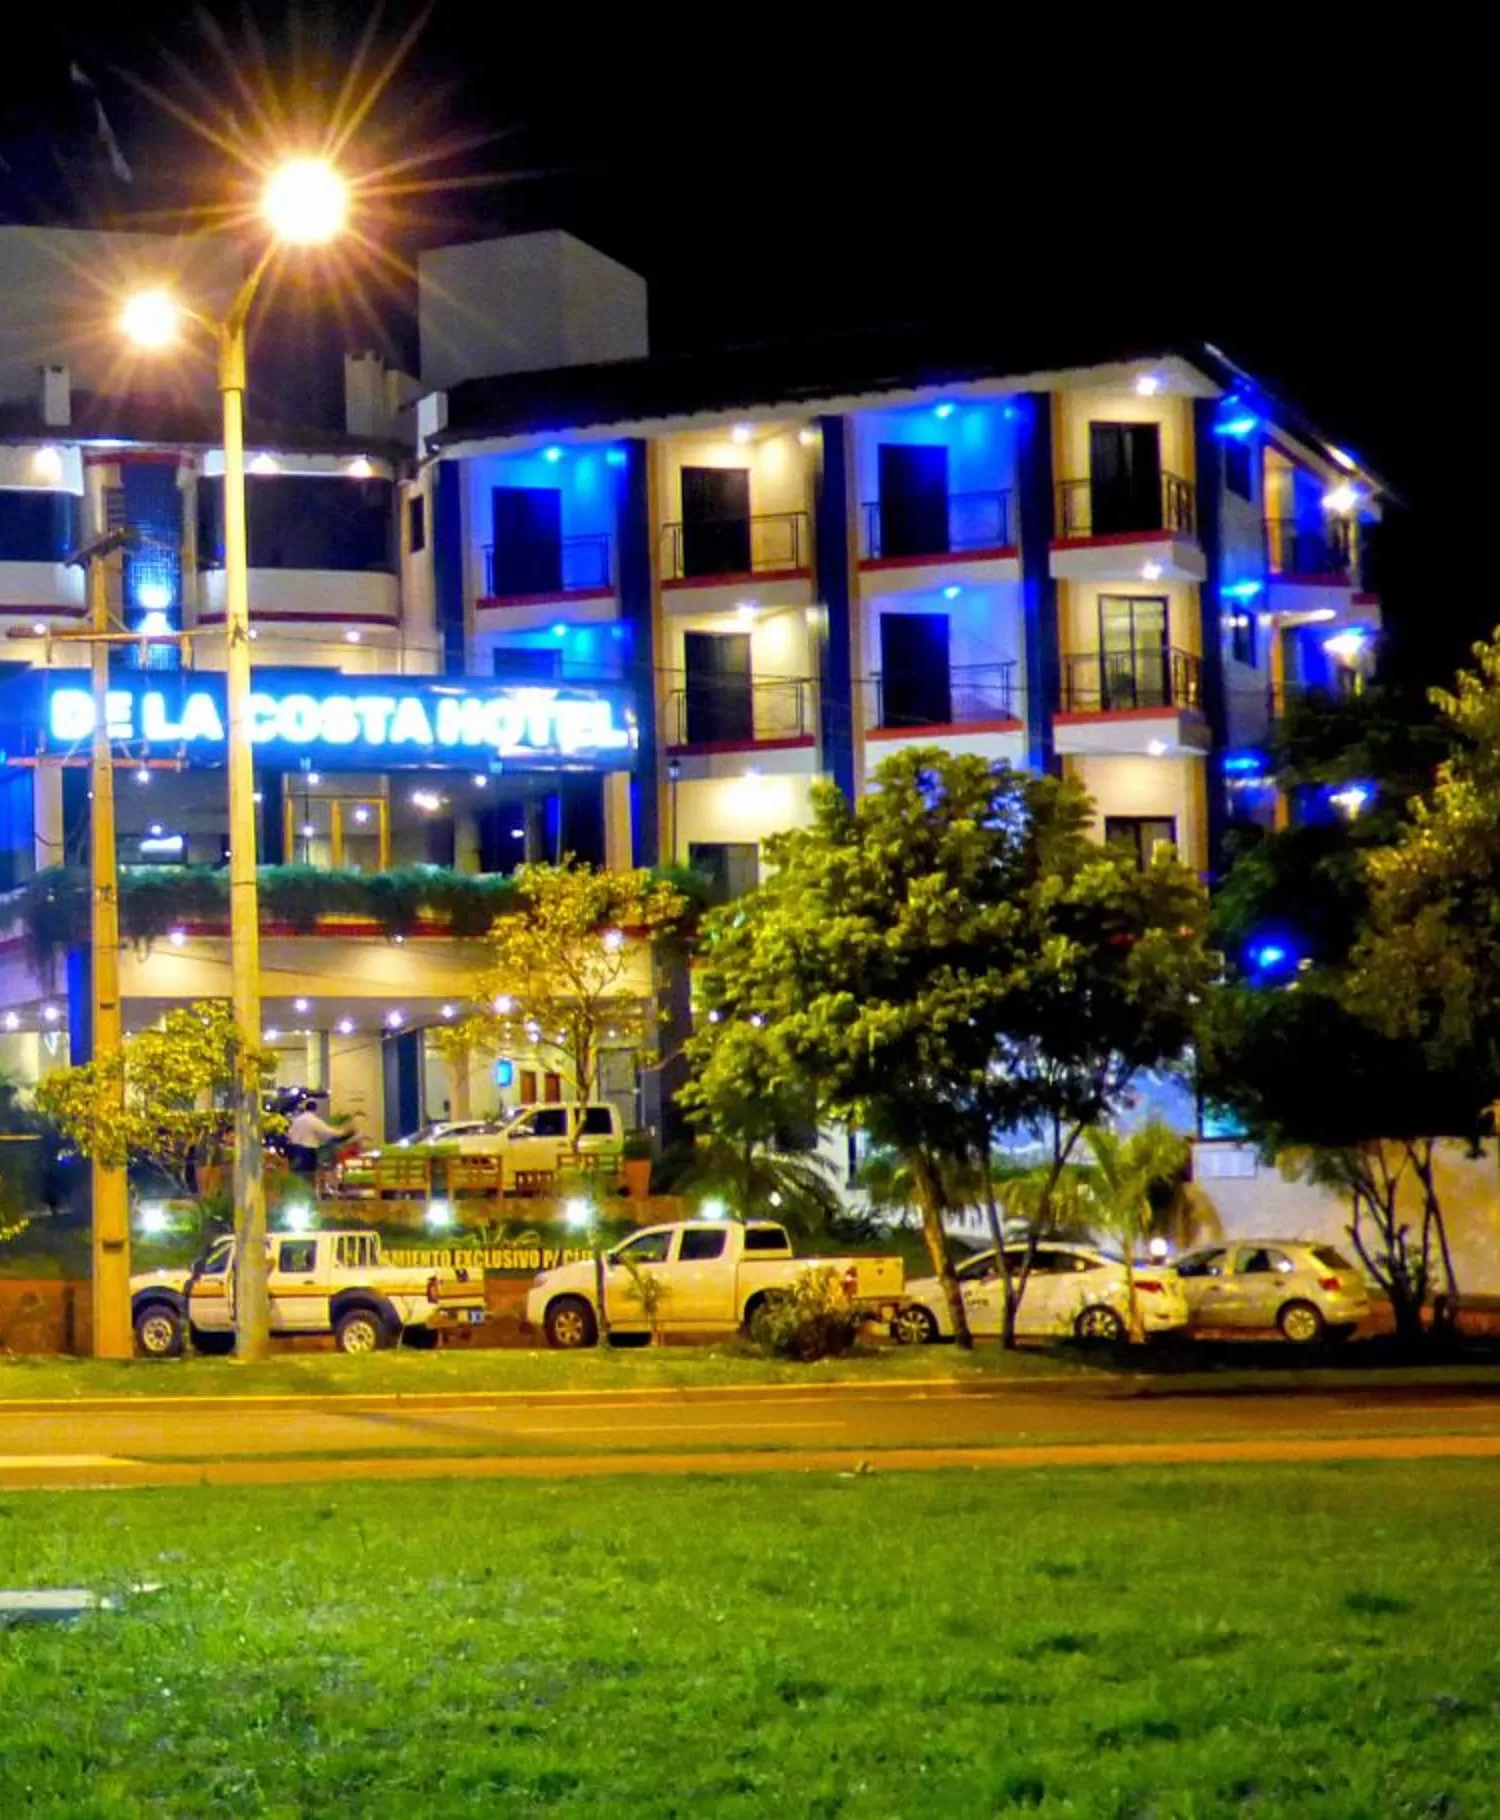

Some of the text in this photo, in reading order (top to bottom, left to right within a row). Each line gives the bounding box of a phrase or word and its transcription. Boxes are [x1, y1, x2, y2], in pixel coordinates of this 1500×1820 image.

[51, 689, 630, 749] DE LA COSTA HOTEL
[456, 1249, 540, 1269] EXCLUSIVO
